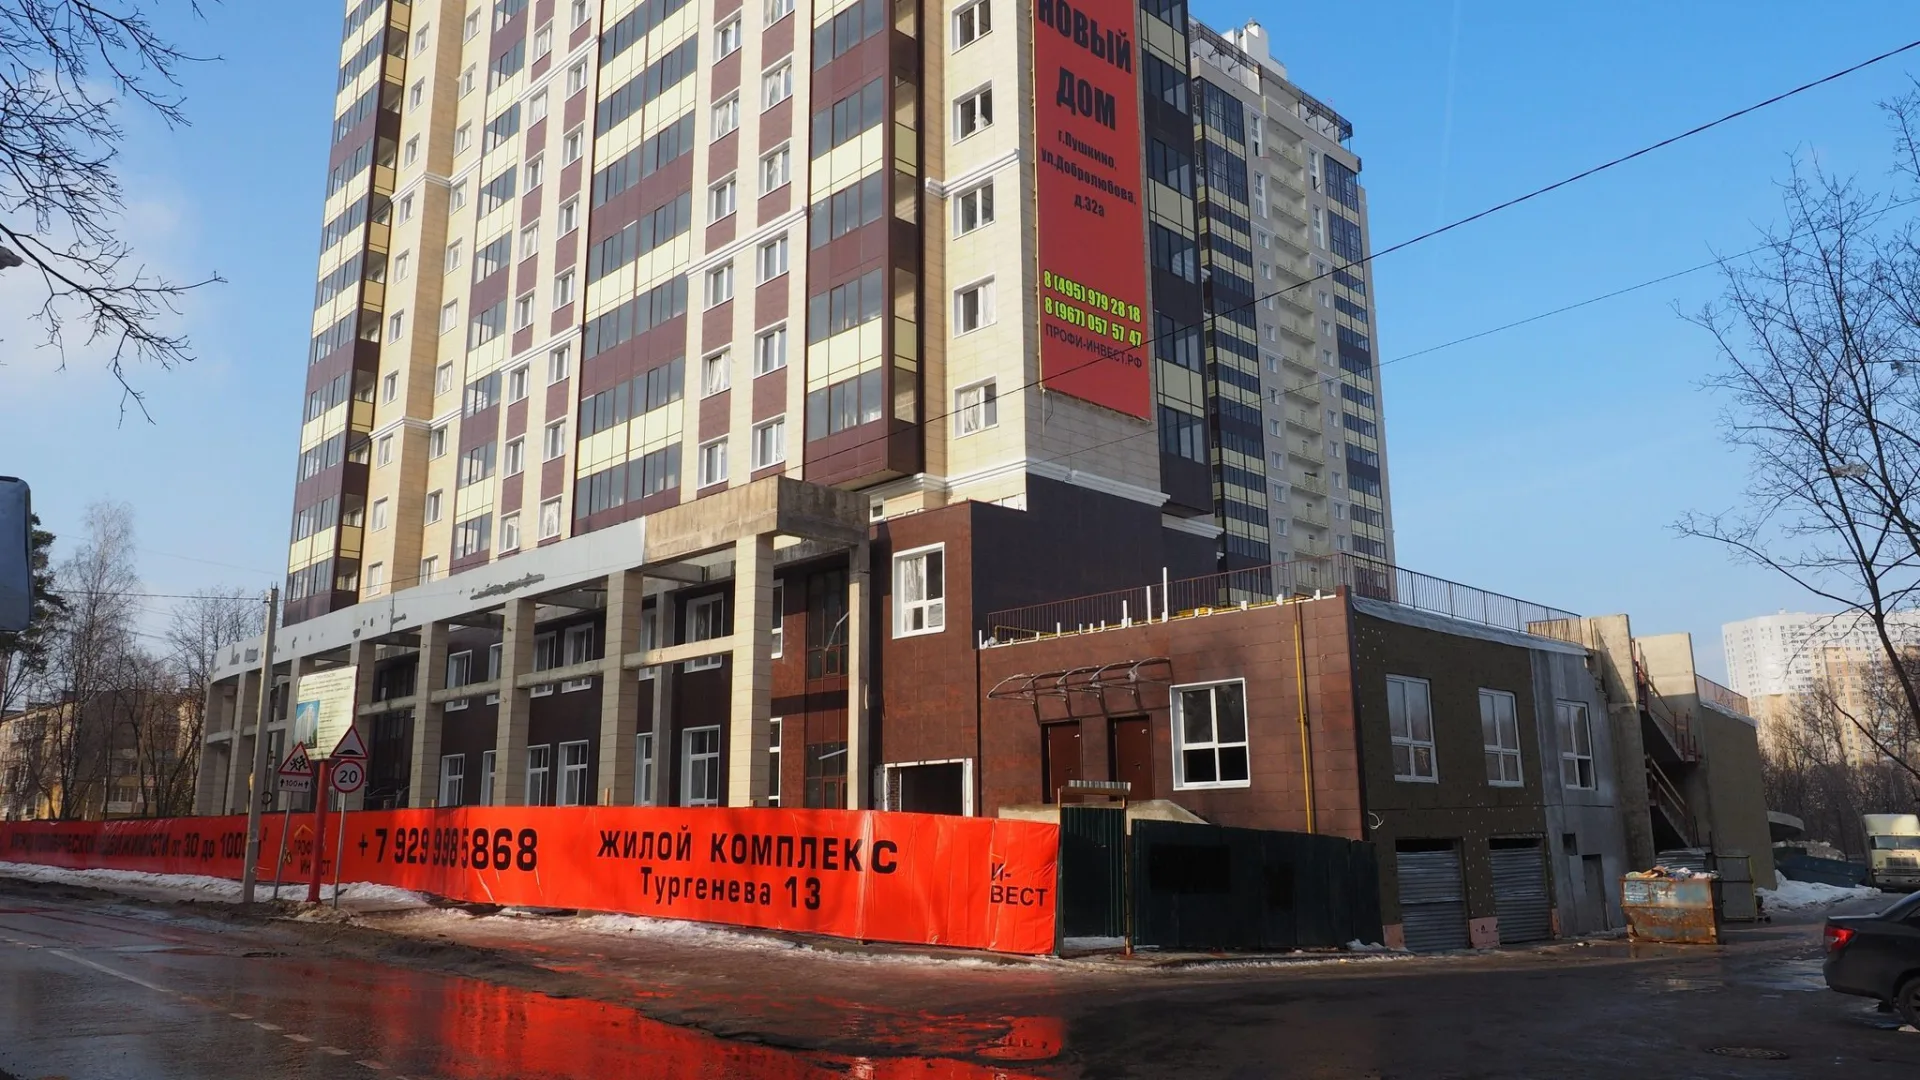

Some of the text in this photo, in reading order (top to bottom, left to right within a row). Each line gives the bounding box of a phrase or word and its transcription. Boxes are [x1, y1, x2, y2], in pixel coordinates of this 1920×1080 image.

[1038, 0, 1131, 74] НОВЫЙ
[1056, 66, 1115, 131] ДОМ
[1074, 194, 1105, 217] д.32а
[1043, 270, 1141, 323] 8 (495) 979 28 18
[1044, 297, 1142, 348] 8 (967) 057 57 47
[1045, 323, 1142, 368] ПРОФИ-ИНВЕСТ.РФ
[338, 770, 358, 784] 20
[184, 832, 199, 858] 30
[202, 839, 215, 862] до
[394, 827, 430, 865] 929
[597, 825, 898, 874] ЖИЛОЙ КОМПЛЕКС
[640, 866, 821, 910] Тургенева 13
[990, 885, 1048, 907] ВЕСТ
